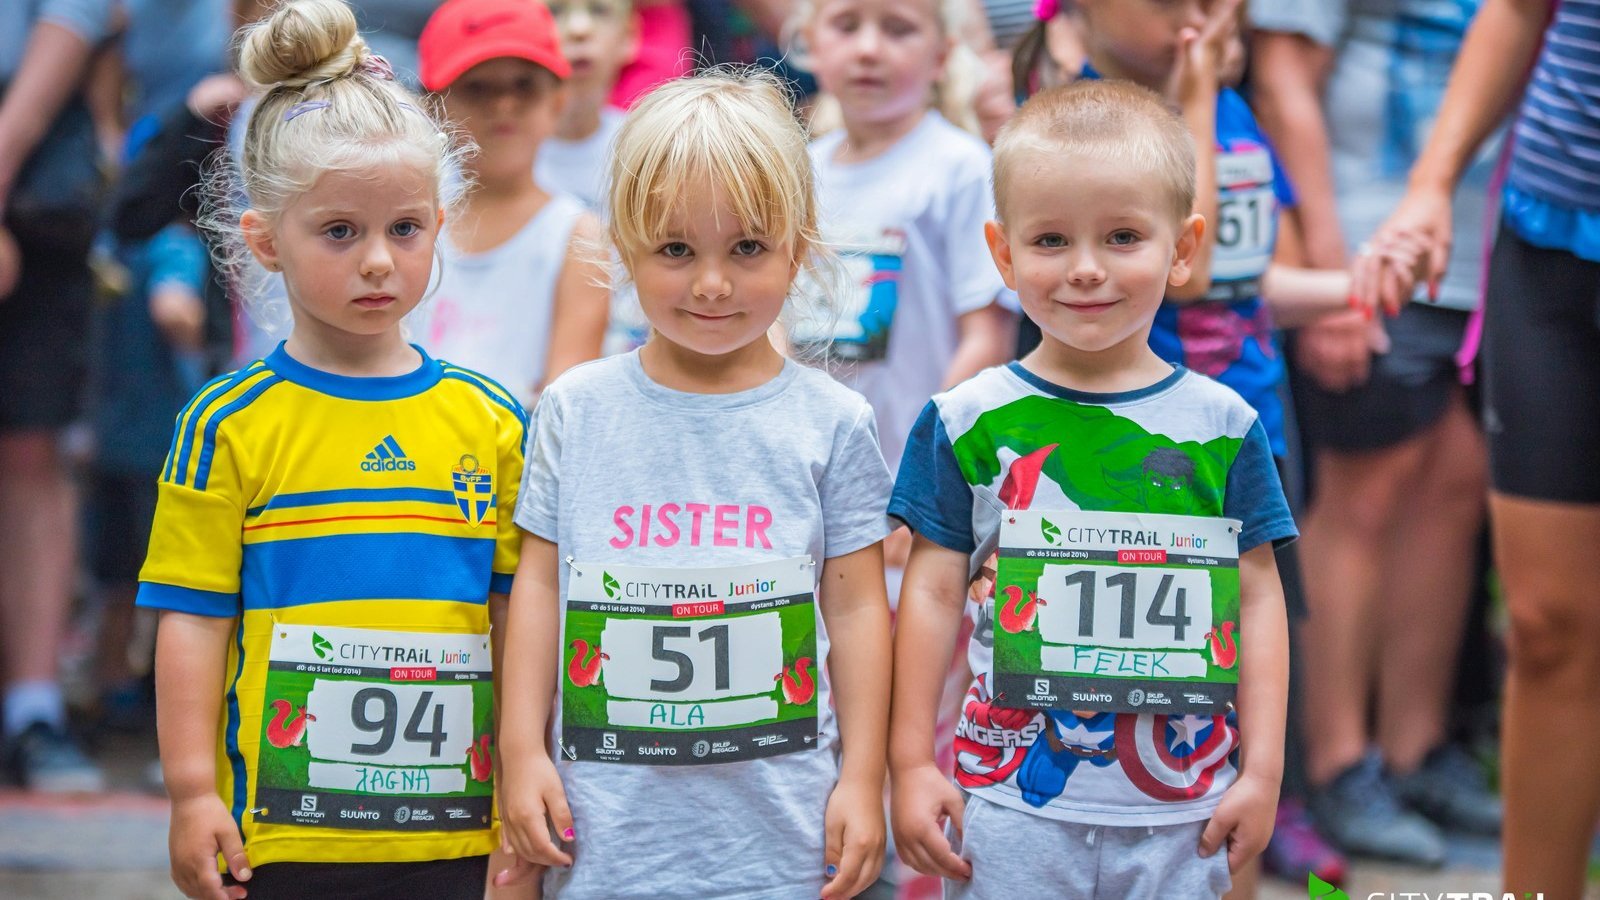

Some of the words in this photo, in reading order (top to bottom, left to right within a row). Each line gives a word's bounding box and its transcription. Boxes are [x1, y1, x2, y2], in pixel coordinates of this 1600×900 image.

[361, 458, 416, 472] adidas
[609, 502, 773, 550] SISTER
[1170, 532, 1208, 549] Junior
[728, 578, 776, 596] Junior
[676, 606, 690, 615] ON
[694, 604, 719, 613] TOUR
[1065, 570, 1191, 642] 114
[440, 649, 470, 664] Junior
[650, 624, 730, 692] 51
[1074, 646, 1170, 678] FELEK
[343, 668, 361, 676] 2014)
[394, 670, 407, 678] ON
[410, 670, 432, 678] TOUR
[1072, 693, 1112, 702] SUUNTO
[350, 687, 448, 757] 94
[650, 704, 705, 726] ALA
[639, 747, 677, 756] SUUNTO
[292, 810, 324, 818] salomon
[340, 810, 380, 820] SUUNTO
